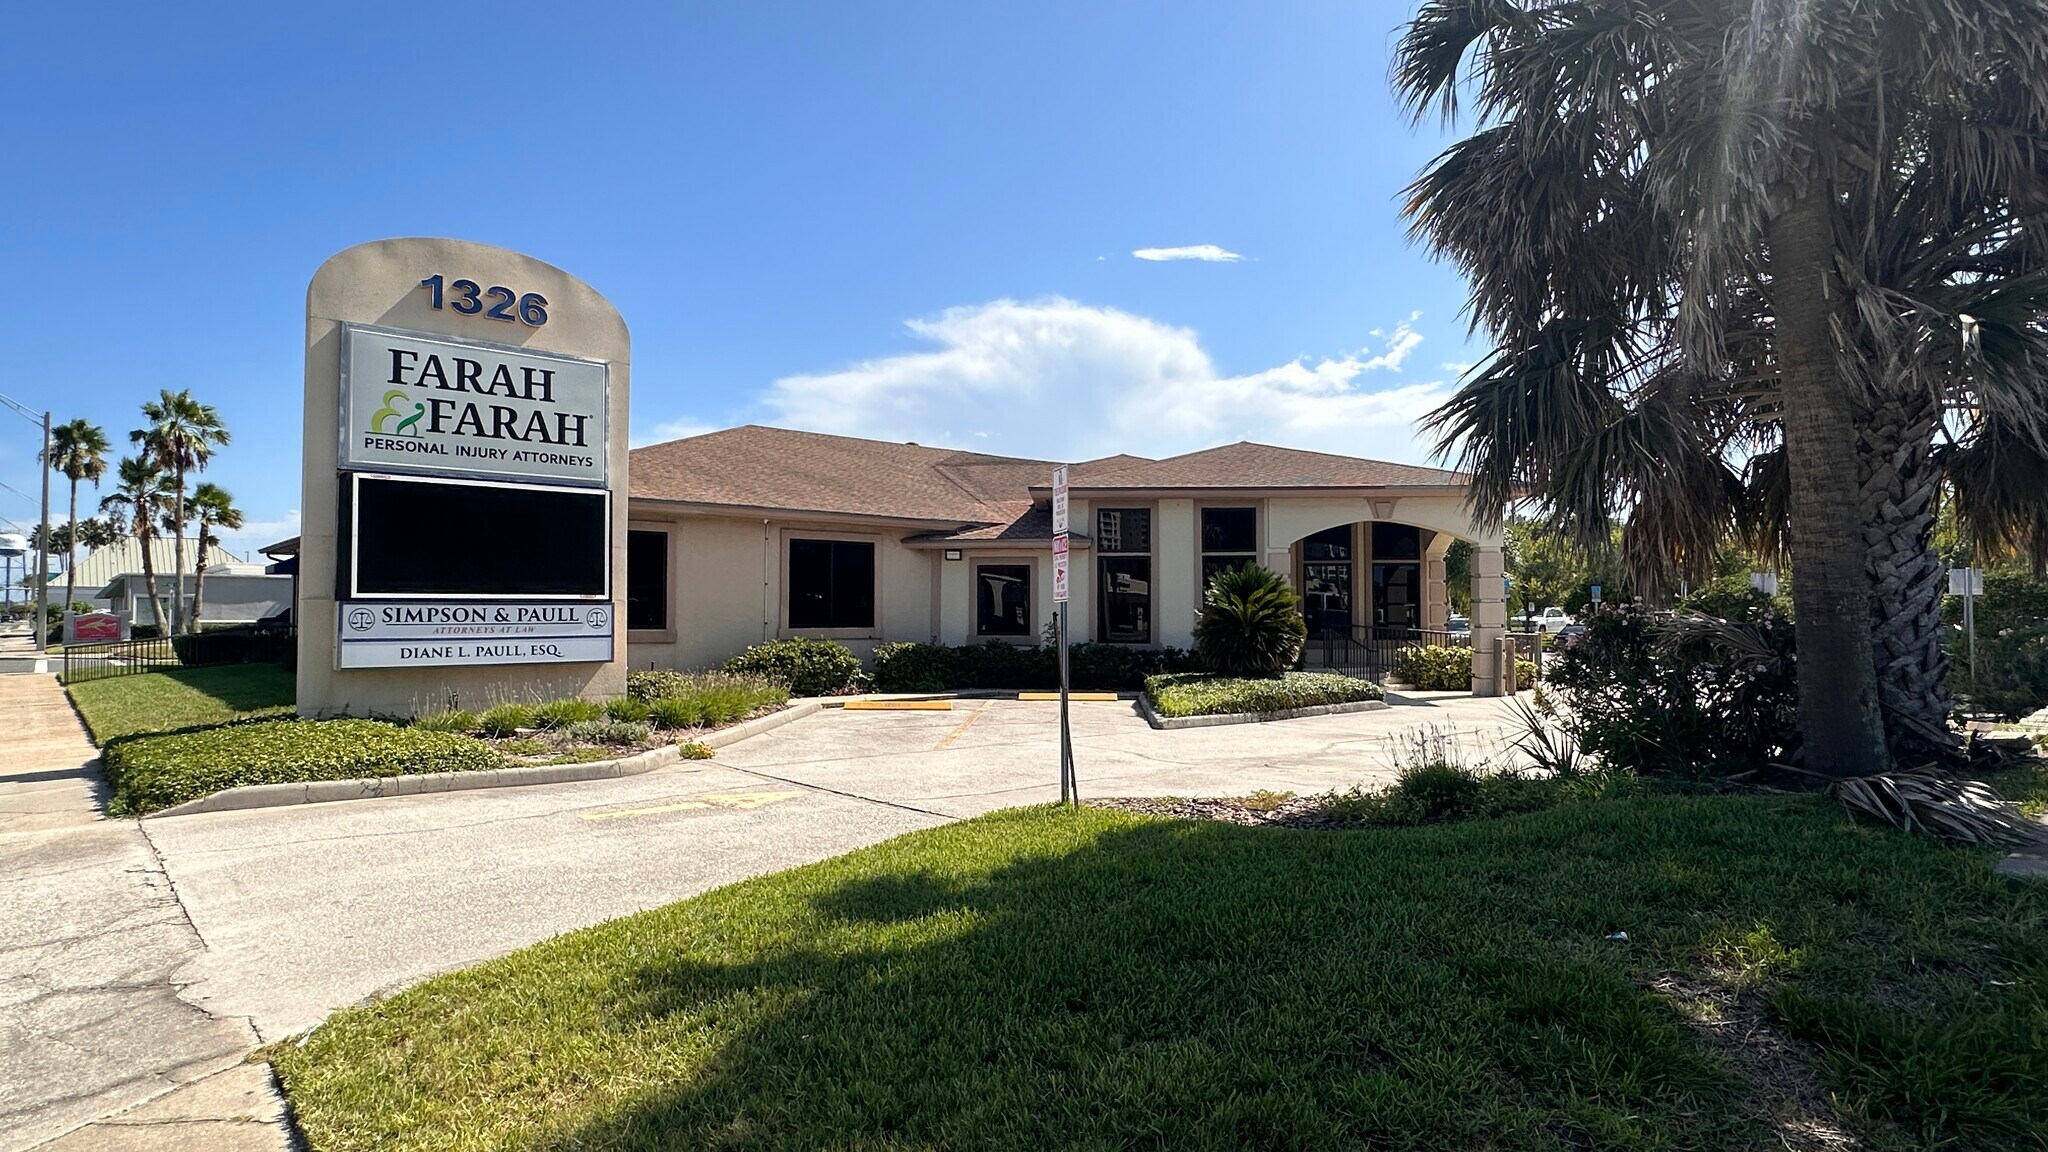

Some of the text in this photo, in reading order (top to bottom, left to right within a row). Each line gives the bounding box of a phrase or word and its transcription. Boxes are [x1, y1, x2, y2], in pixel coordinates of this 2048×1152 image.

[420, 274, 549, 327] 1326
[387, 348, 556, 403] FARAH
[371, 389, 588, 447] & FARAH
[364, 437, 593, 467] PERSONAL INJURY ATTORNEYS
[382, 607, 579, 623] SIMPSON & PAULL
[432, 626, 537, 635] ATTORNEYS AT LAW
[400, 644, 565, 660] DIANE L. PAULL, ESQ.
